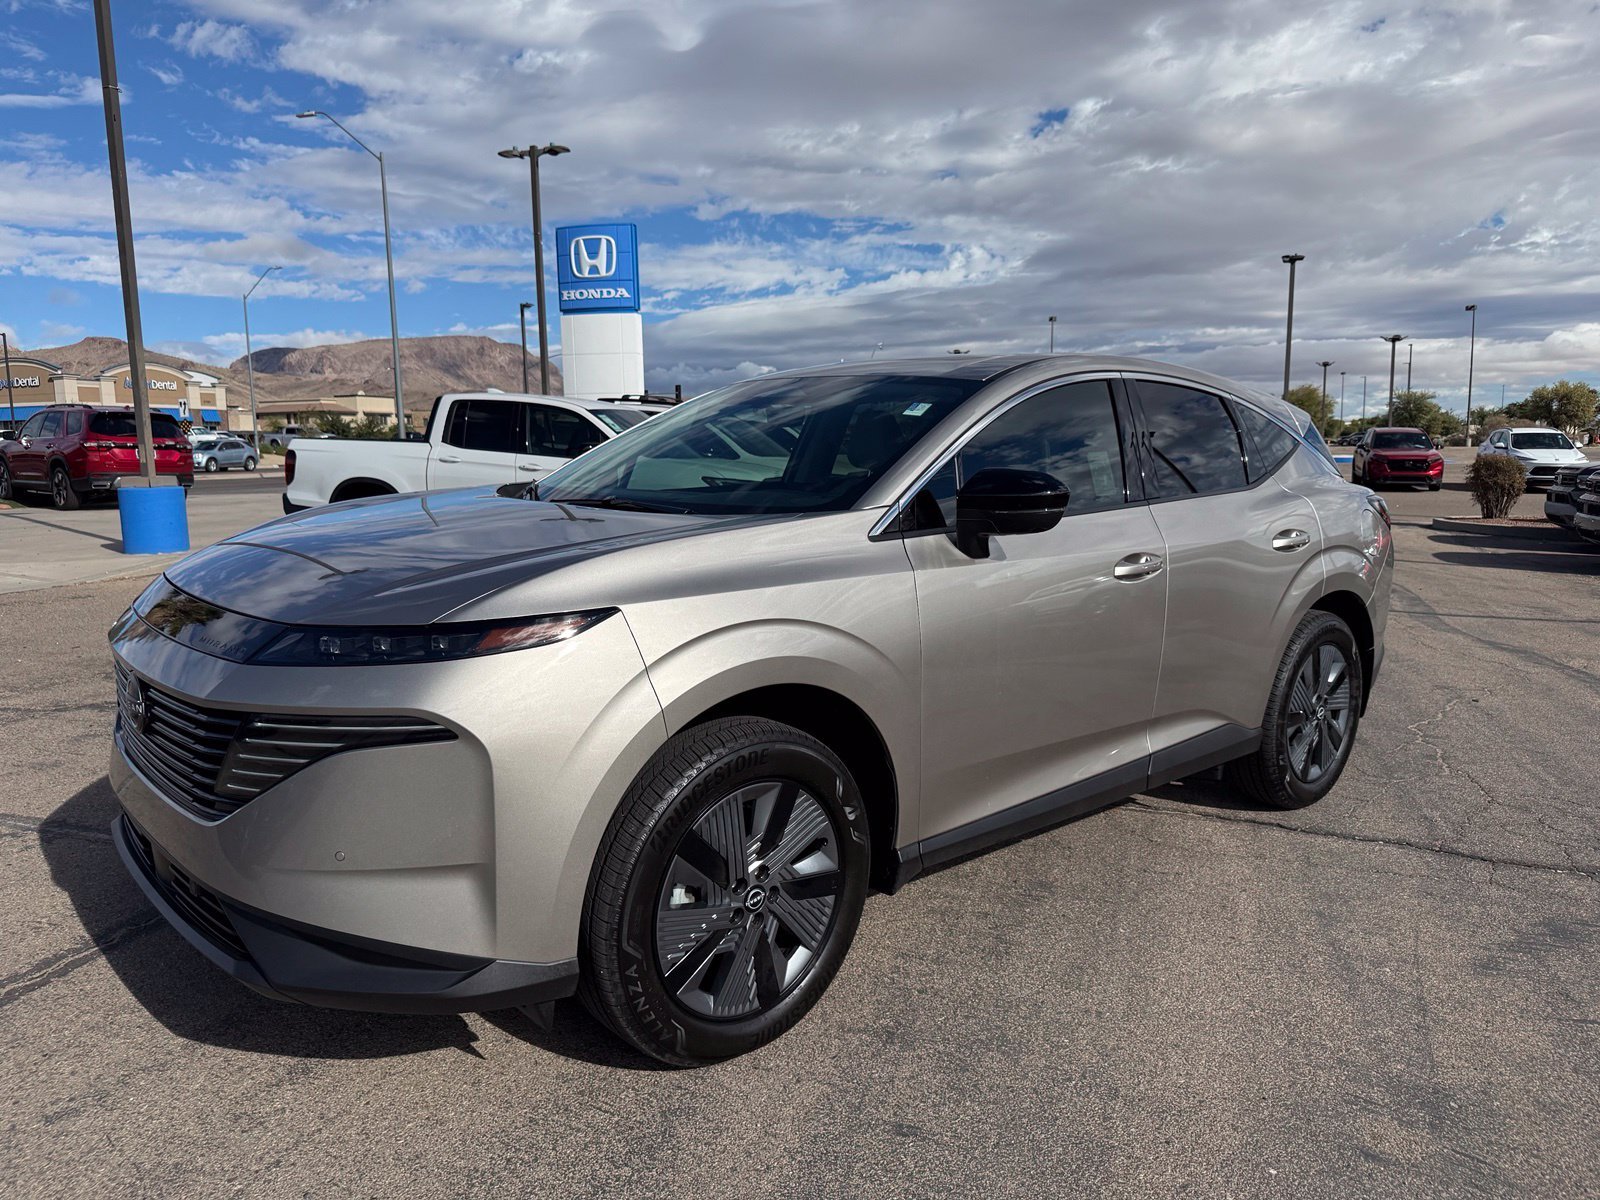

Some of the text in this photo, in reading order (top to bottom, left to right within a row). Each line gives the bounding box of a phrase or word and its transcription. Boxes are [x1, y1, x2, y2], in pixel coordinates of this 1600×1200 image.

[561, 288, 631, 301] HONDA
[649, 747, 771, 853] BRIDGESTONE
[624, 963, 673, 1041] ALENZA
